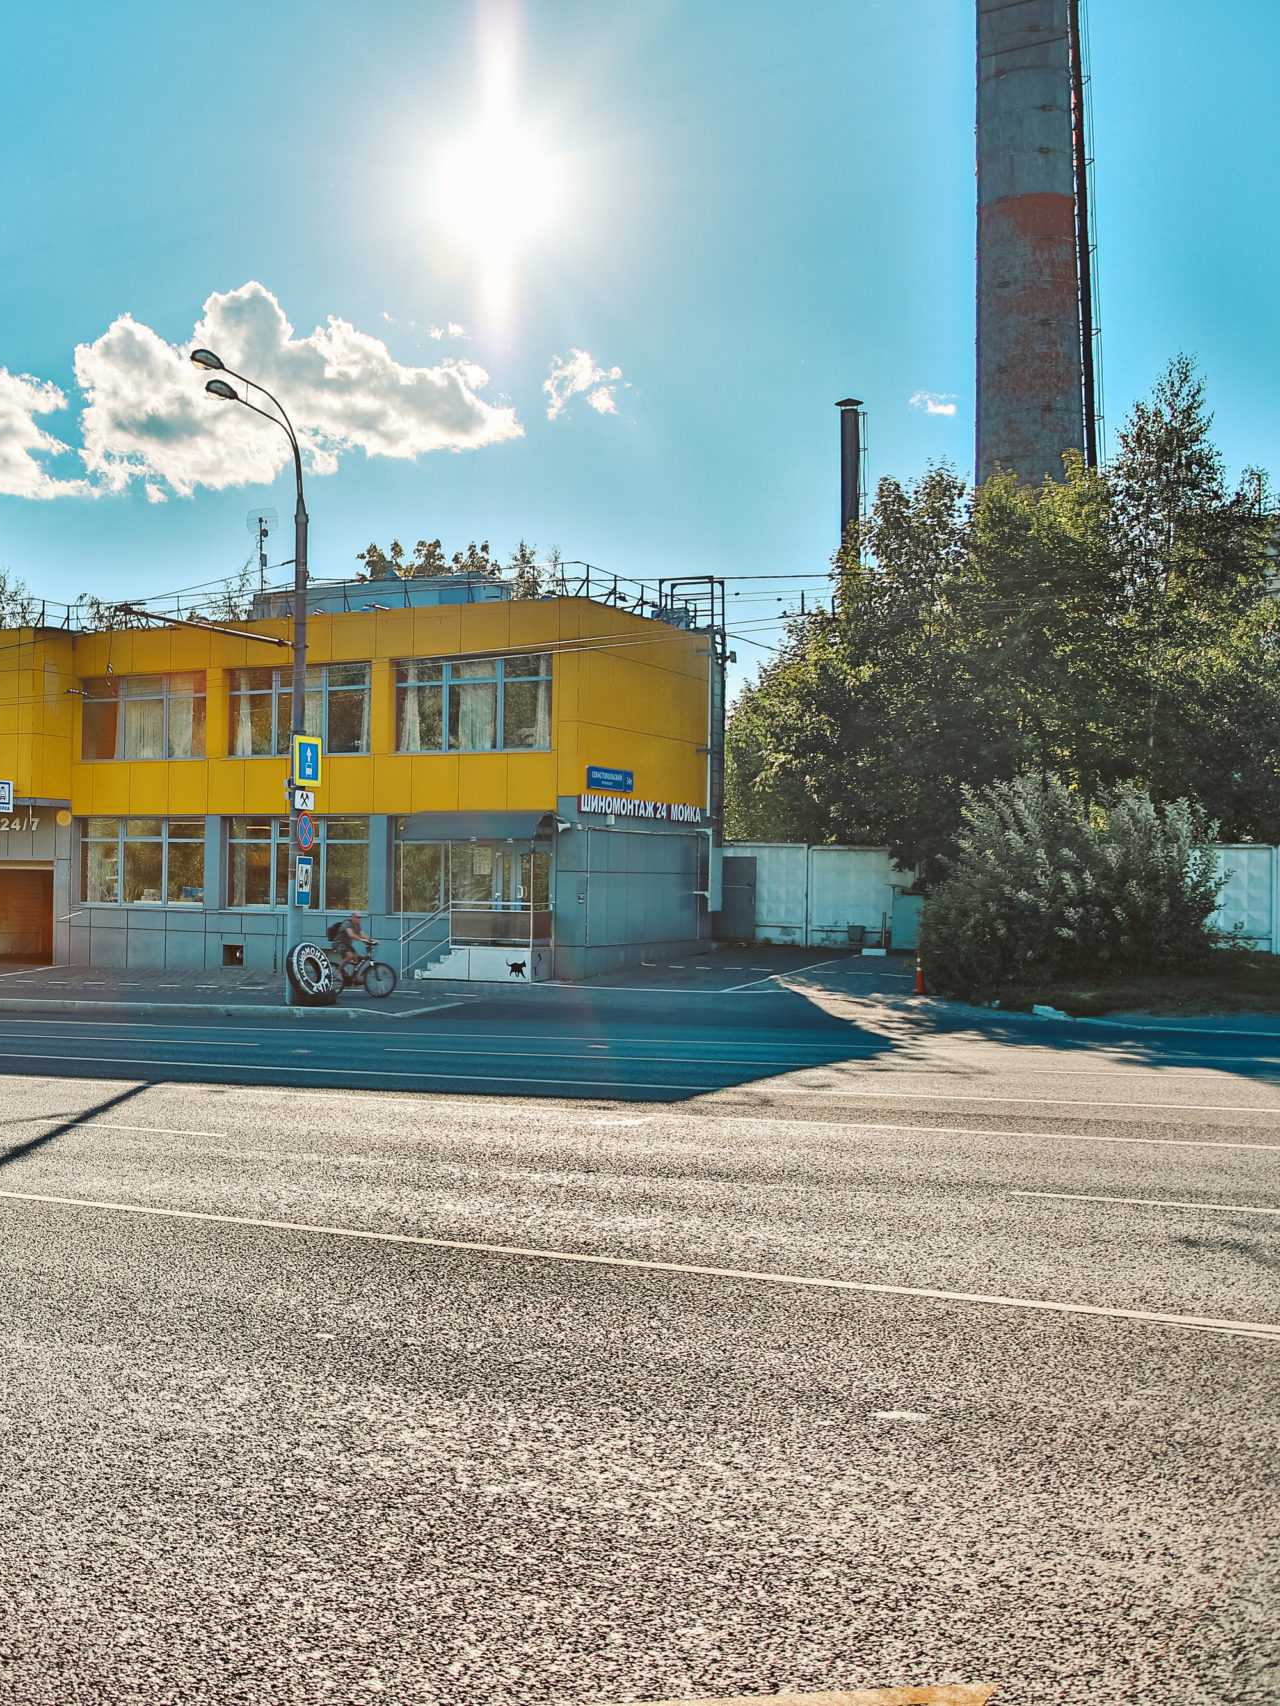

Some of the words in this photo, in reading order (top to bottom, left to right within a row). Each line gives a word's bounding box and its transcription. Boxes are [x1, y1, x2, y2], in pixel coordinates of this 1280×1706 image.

[581, 794, 654, 818] ШИНОМОНТАЖ
[656, 804, 667, 819] 24
[670, 803, 701, 823] МОЙКА
[0, 818, 40, 831] 24/7
